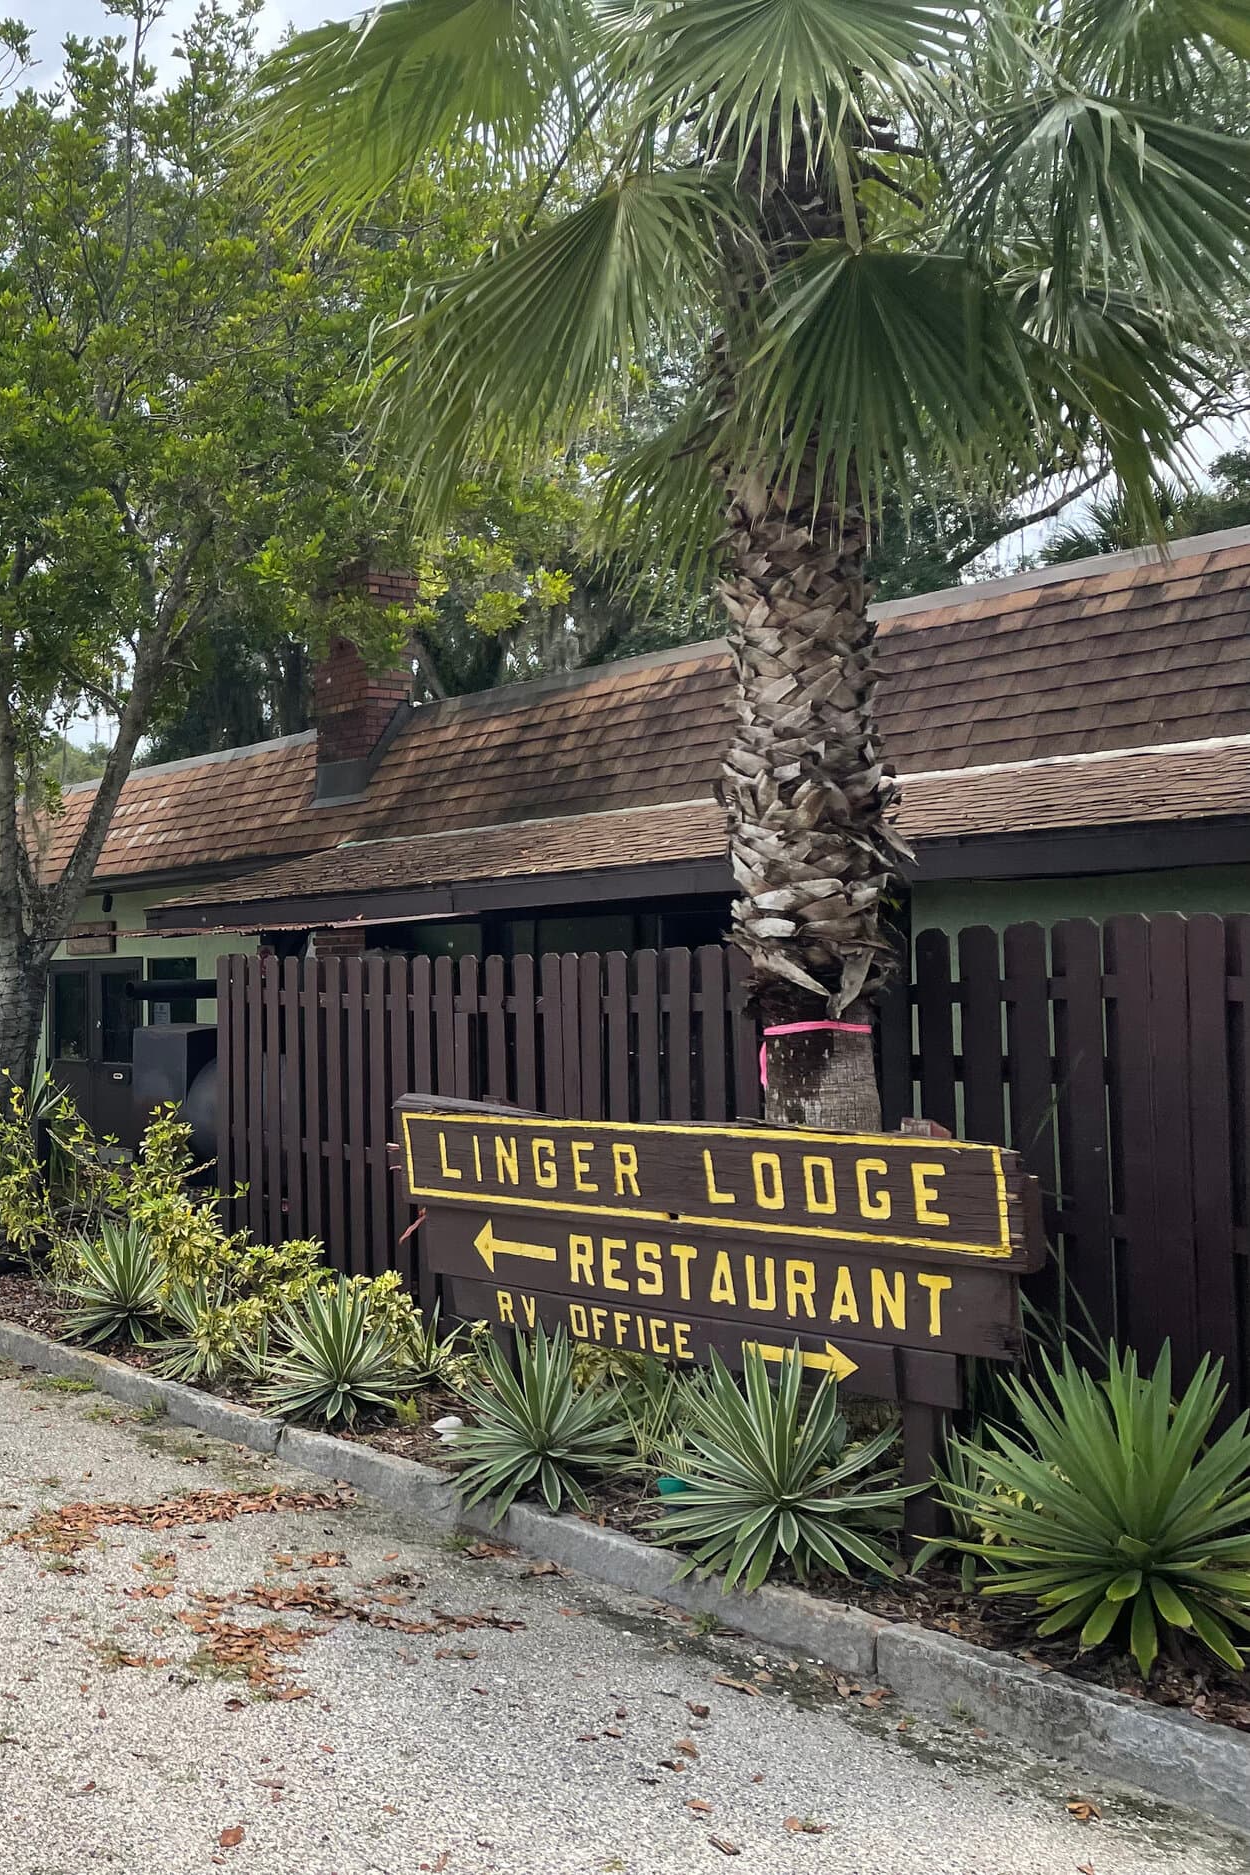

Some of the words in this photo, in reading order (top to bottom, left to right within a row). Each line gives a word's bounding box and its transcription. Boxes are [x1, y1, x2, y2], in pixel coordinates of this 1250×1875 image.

[439, 1131, 641, 1197] LINGER
[703, 1148, 950, 1226] LODGE
[496, 1289, 537, 1329] RV
[569, 1303, 695, 1360] OFFICE
[568, 1233, 953, 1338] RESTAURANT
